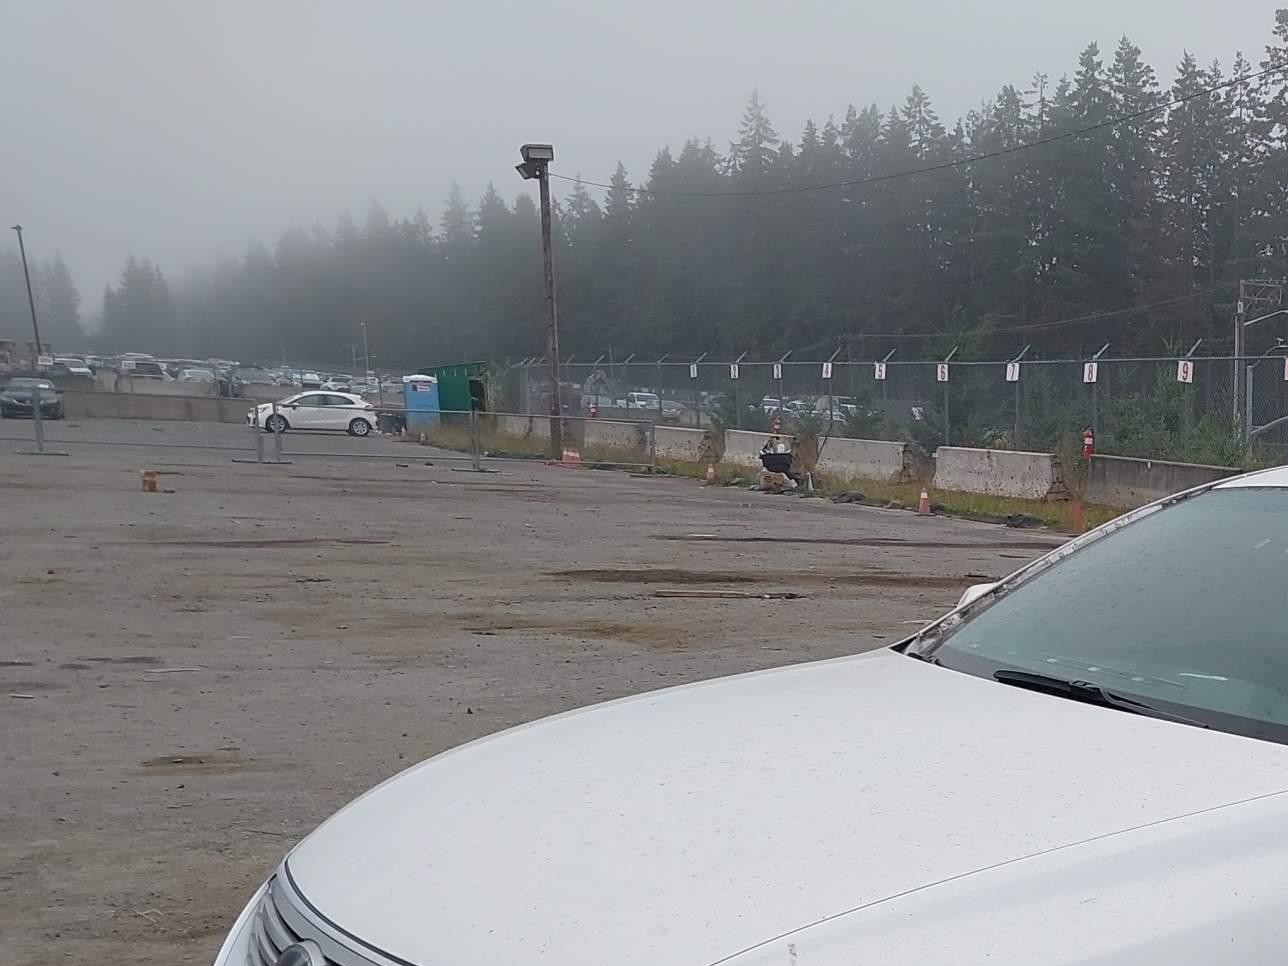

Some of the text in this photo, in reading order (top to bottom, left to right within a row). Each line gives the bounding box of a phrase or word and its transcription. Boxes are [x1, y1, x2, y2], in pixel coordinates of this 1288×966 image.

[939, 365, 946, 380] 6
[1009, 365, 1017, 380] 7
[1087, 364, 1094, 381] 8
[1181, 363, 1190, 381] 9
